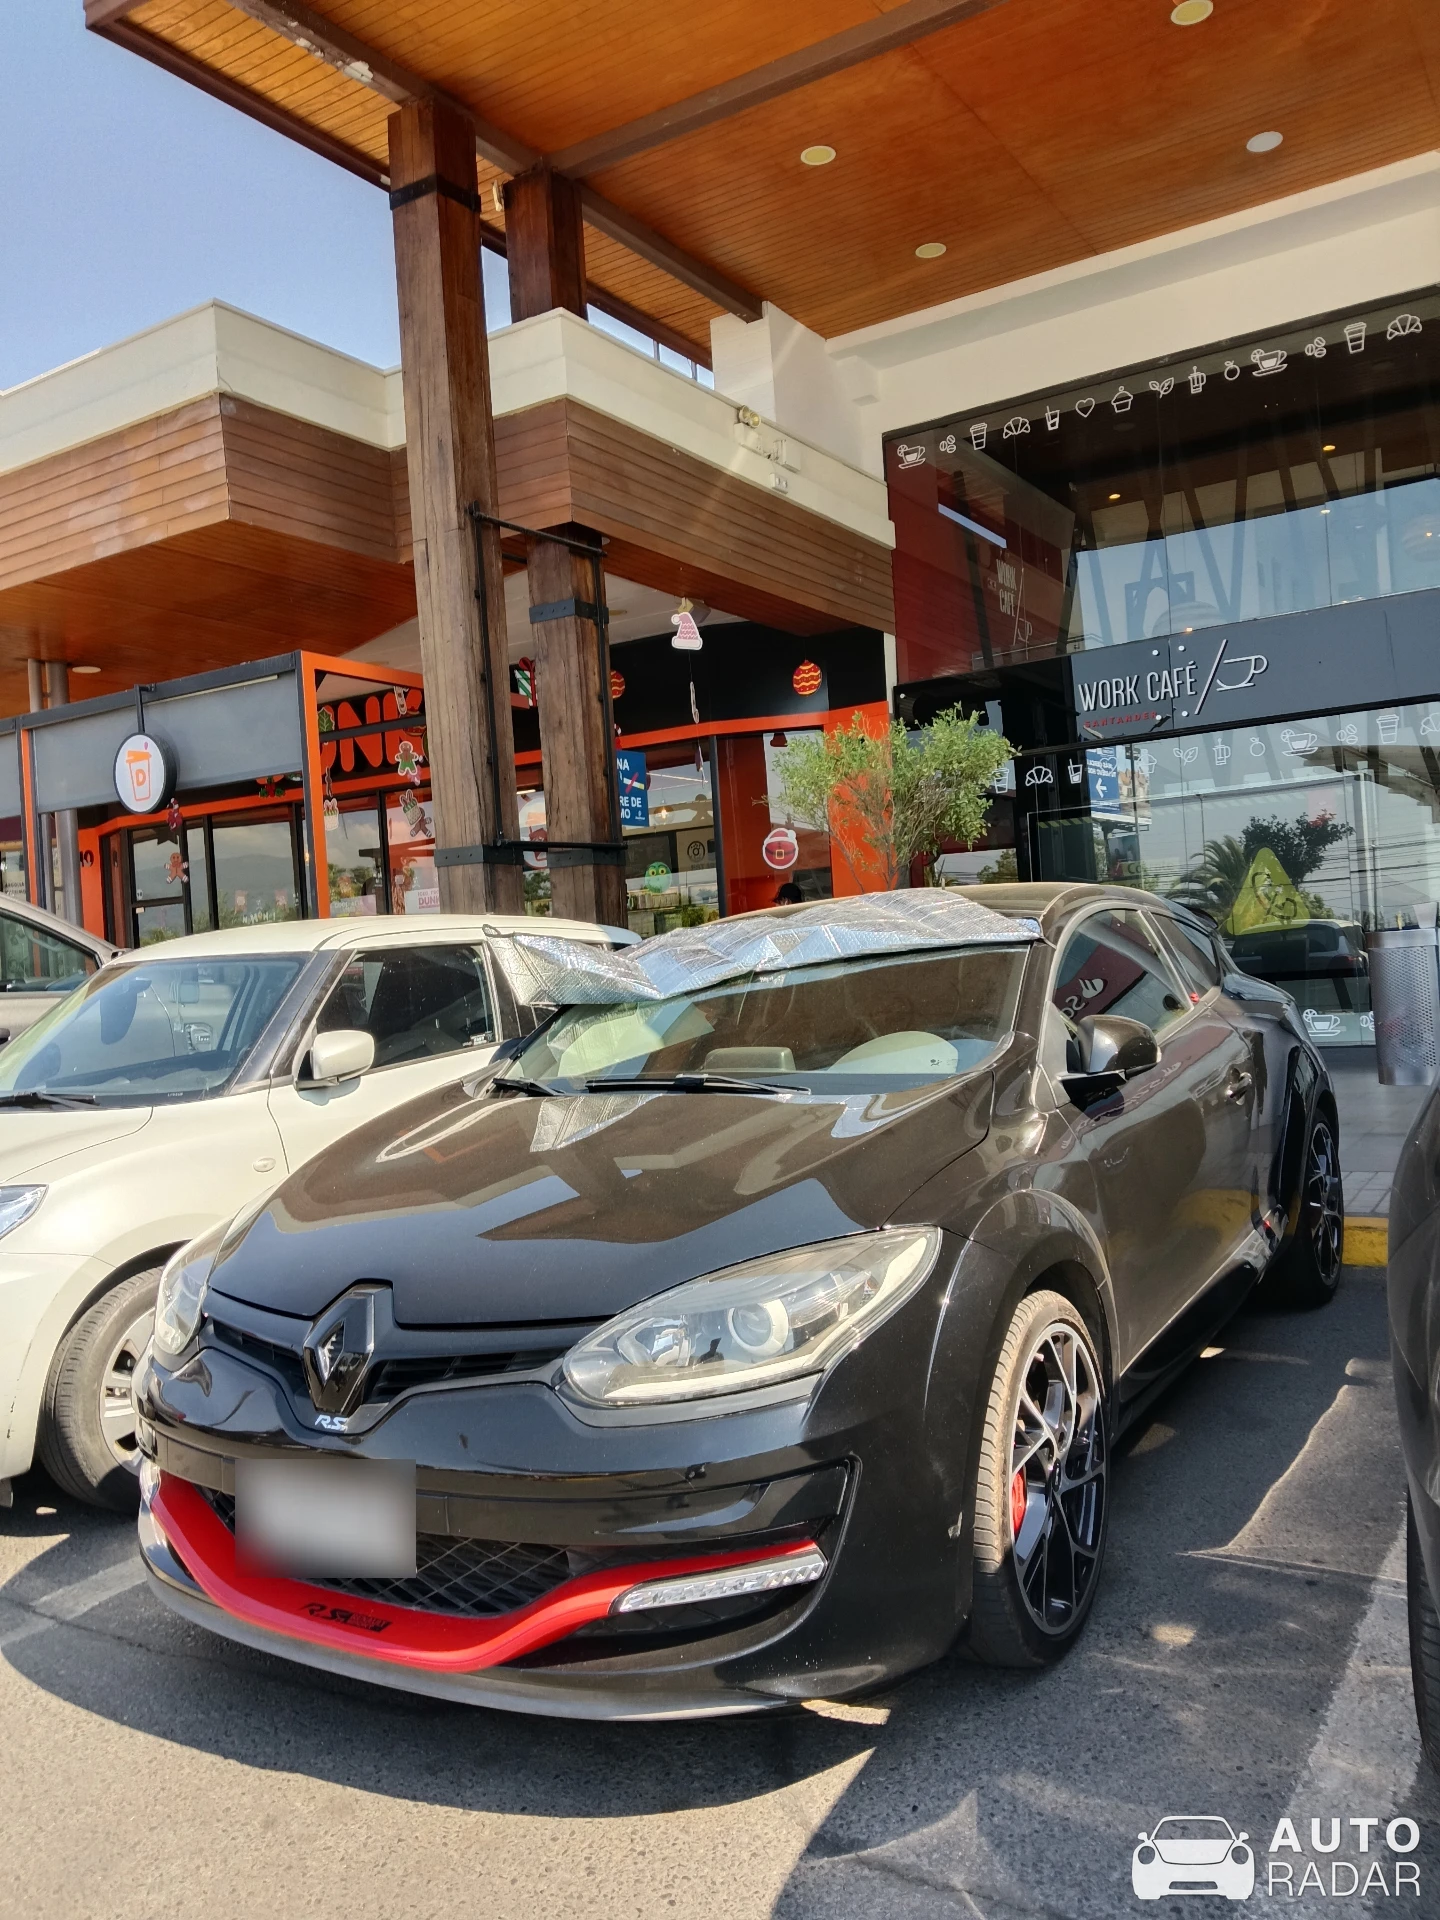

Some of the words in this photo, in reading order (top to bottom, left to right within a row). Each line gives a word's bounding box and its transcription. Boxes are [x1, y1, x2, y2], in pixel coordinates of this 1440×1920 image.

[1077, 675, 1140, 712] WORK
[1146, 660, 1198, 702] CAFÉ
[1084, 710, 1158, 729] SANTANDER
[135, 768, 147, 787] D
[631, 796, 642, 808] DE
